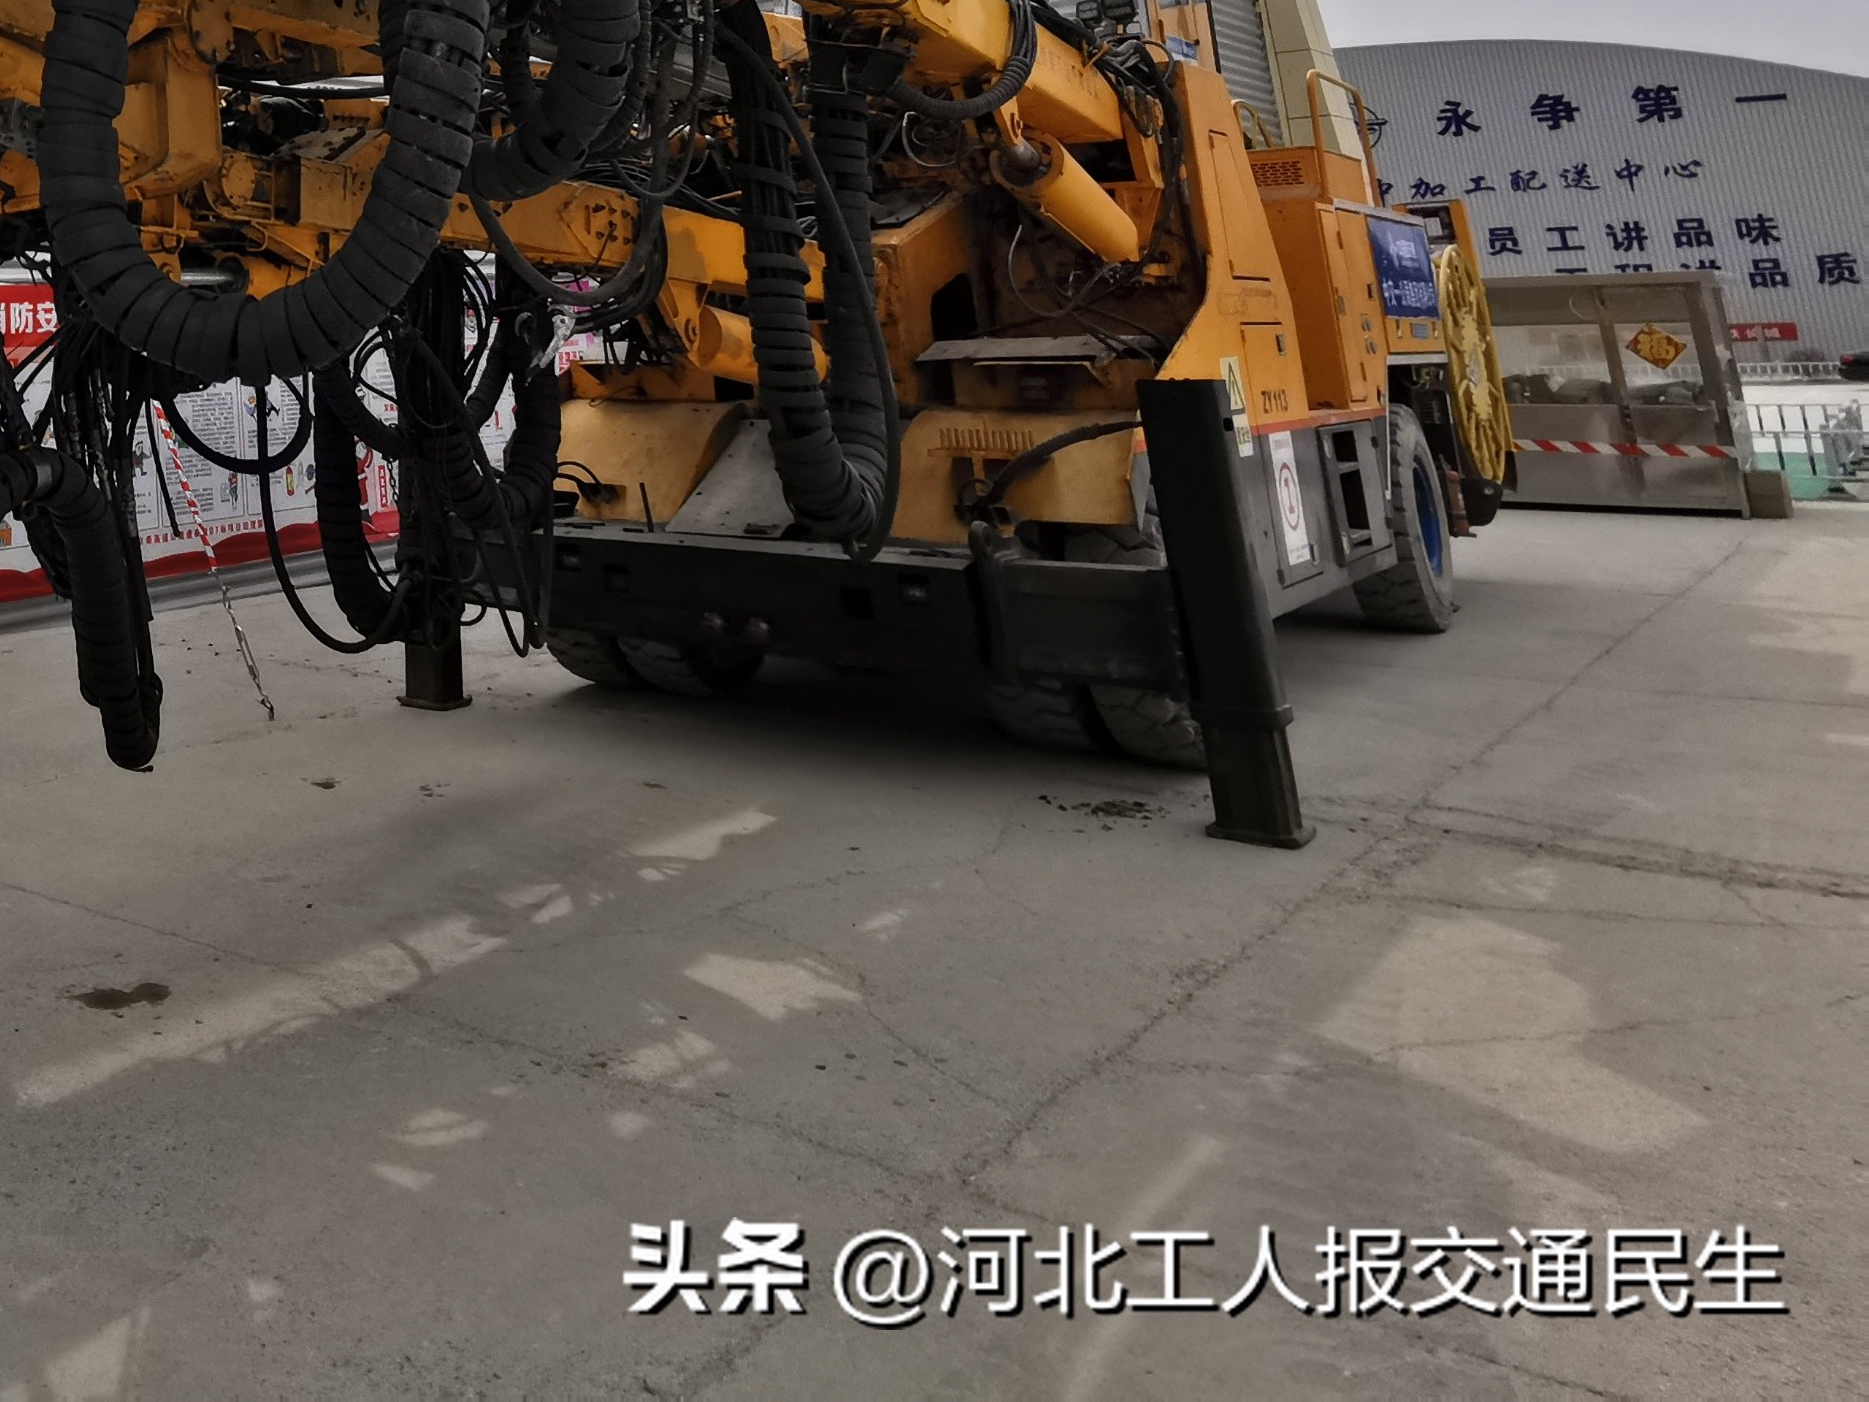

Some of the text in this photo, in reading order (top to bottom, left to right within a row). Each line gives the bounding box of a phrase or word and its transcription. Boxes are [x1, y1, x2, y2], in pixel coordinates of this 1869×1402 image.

[1435, 83, 1788, 137] 永争第一
[1487, 212, 1782, 256] 员工讲品味
